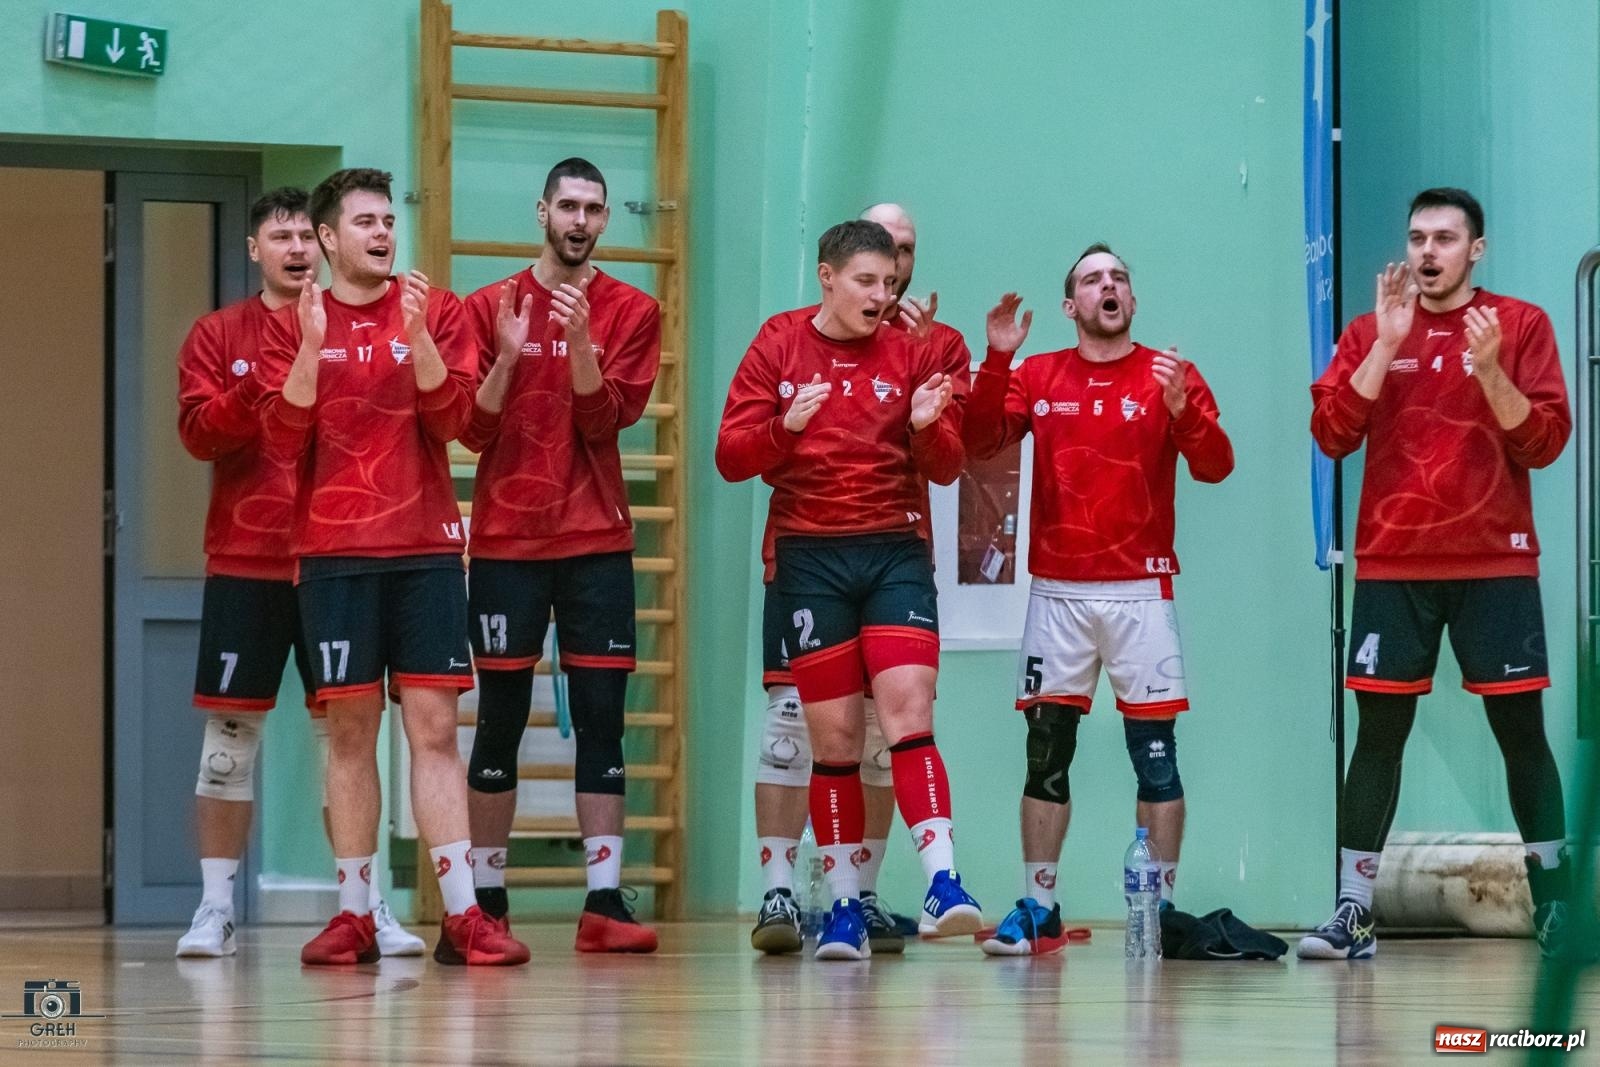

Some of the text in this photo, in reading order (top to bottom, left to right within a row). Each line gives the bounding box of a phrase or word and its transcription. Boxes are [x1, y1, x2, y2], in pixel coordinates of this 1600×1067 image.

[357, 345, 373, 362] 17
[552, 340, 567, 357] 13
[1432, 355, 1443, 373] 4
[842, 379, 853, 397] 2
[1093, 399, 1104, 416] 5
[479, 613, 508, 655] 13
[792, 608, 822, 651] 2
[218, 652, 239, 694] 7
[319, 640, 350, 683] 17
[1355, 632, 1381, 675] 4
[1024, 655, 1044, 696] 5
